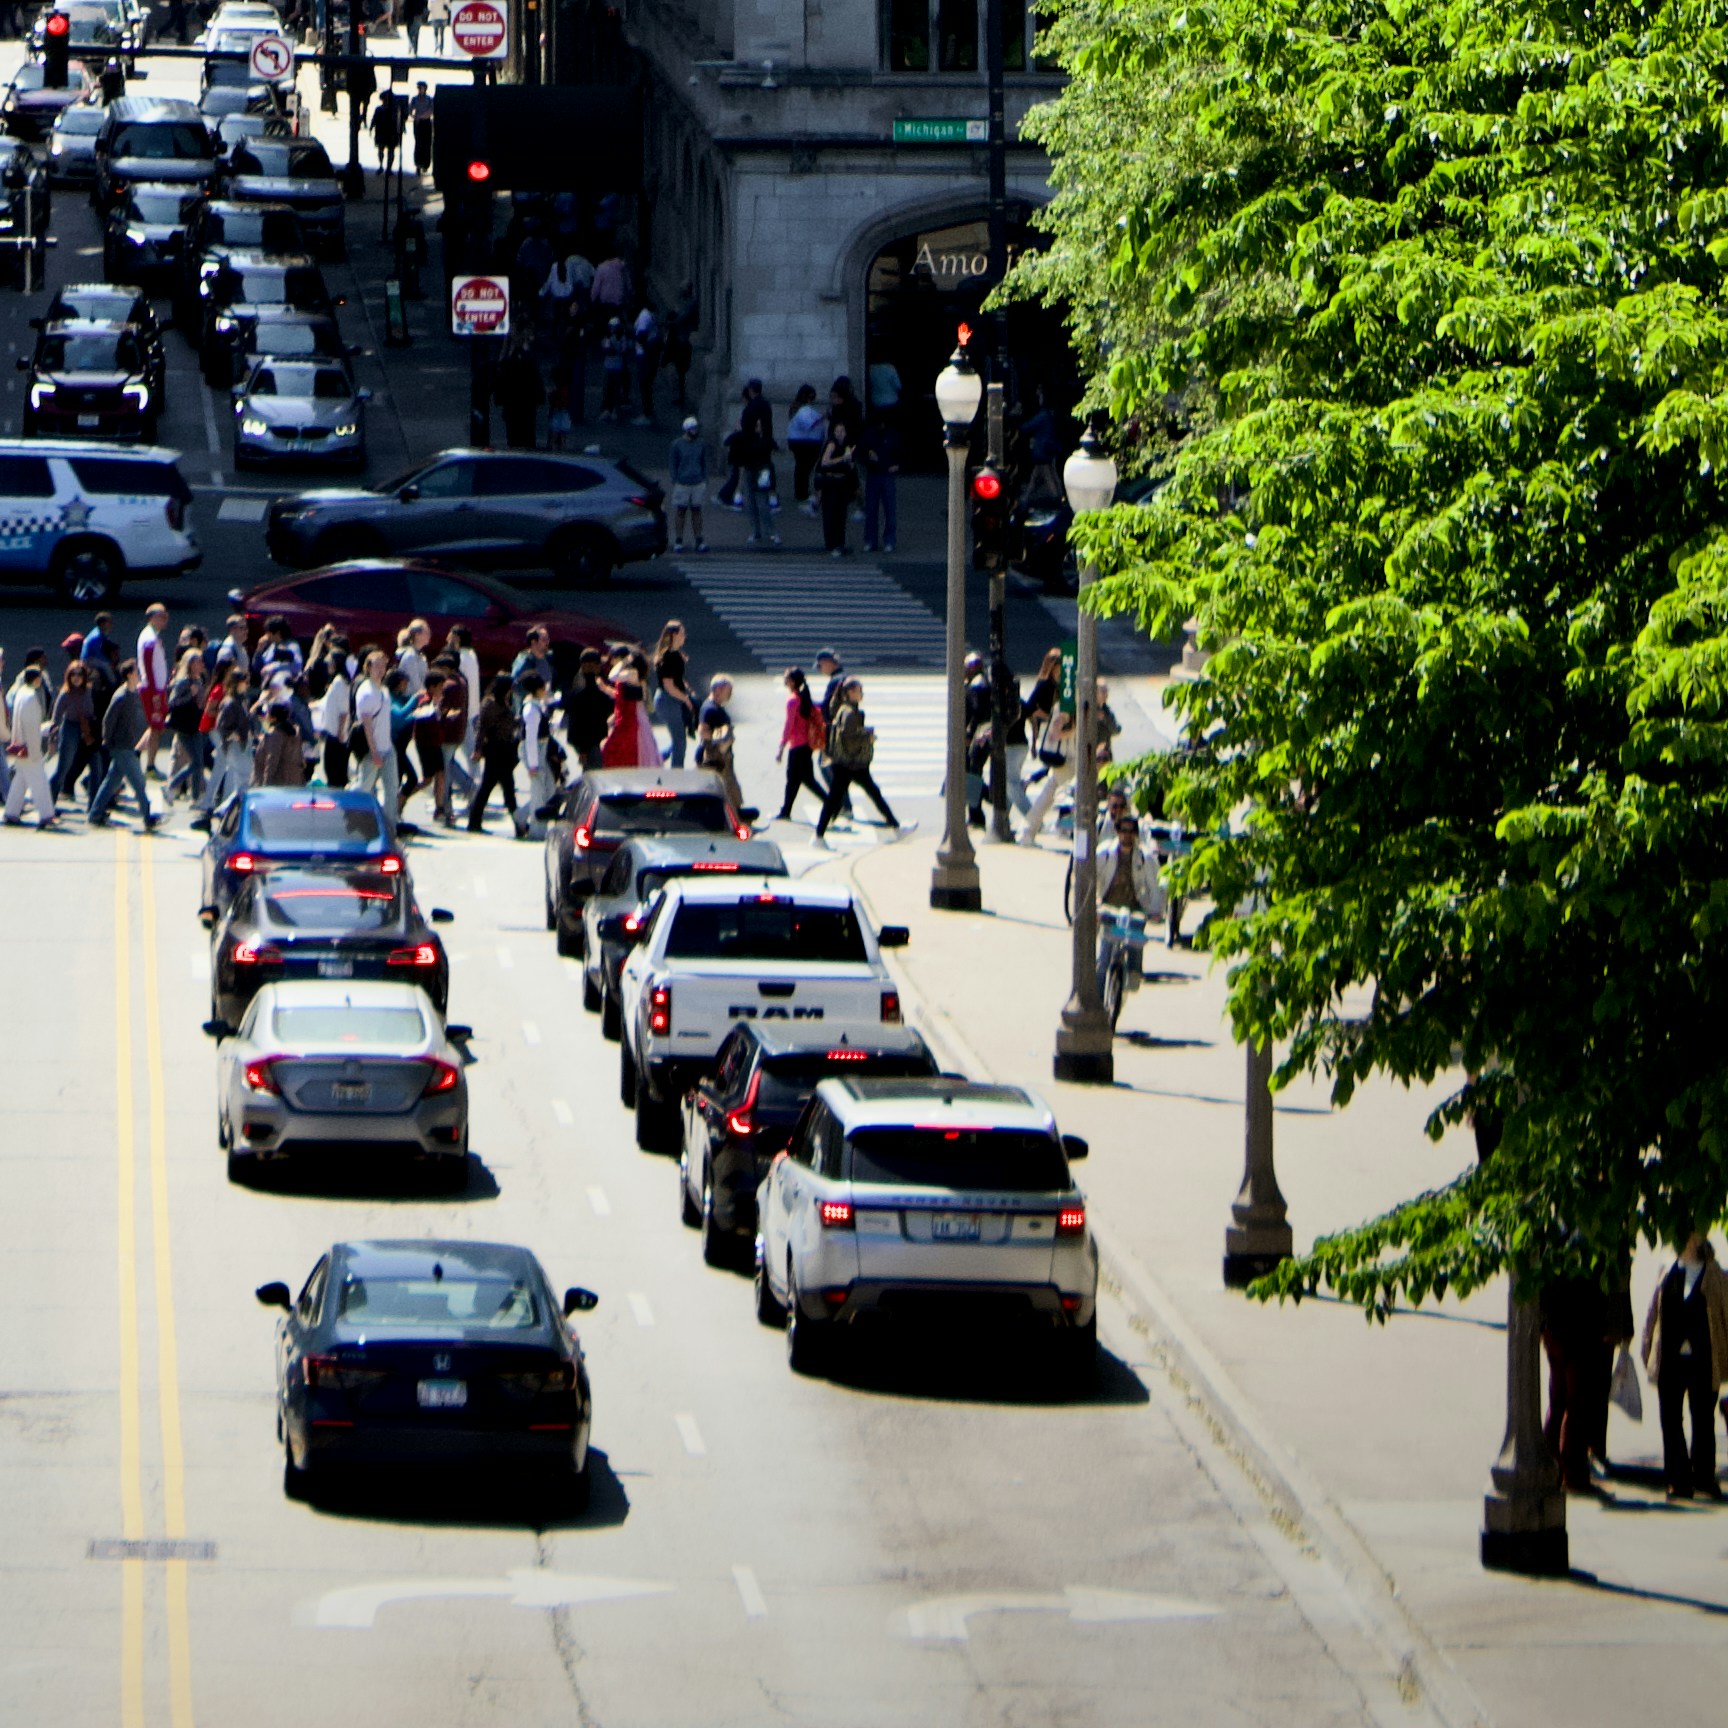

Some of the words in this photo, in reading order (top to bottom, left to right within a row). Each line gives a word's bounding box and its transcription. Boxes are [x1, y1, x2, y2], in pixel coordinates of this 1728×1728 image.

[459, 11, 472, 21] DO
[478, 11, 497, 21] NOT
[464, 36, 494, 45] ENTER
[904, 122, 953, 140] Michigan
[461, 288, 475, 298] DO
[479, 287, 499, 298] NOT
[465, 312, 496, 322] ENTER
[728, 1005, 824, 1019] RAM
